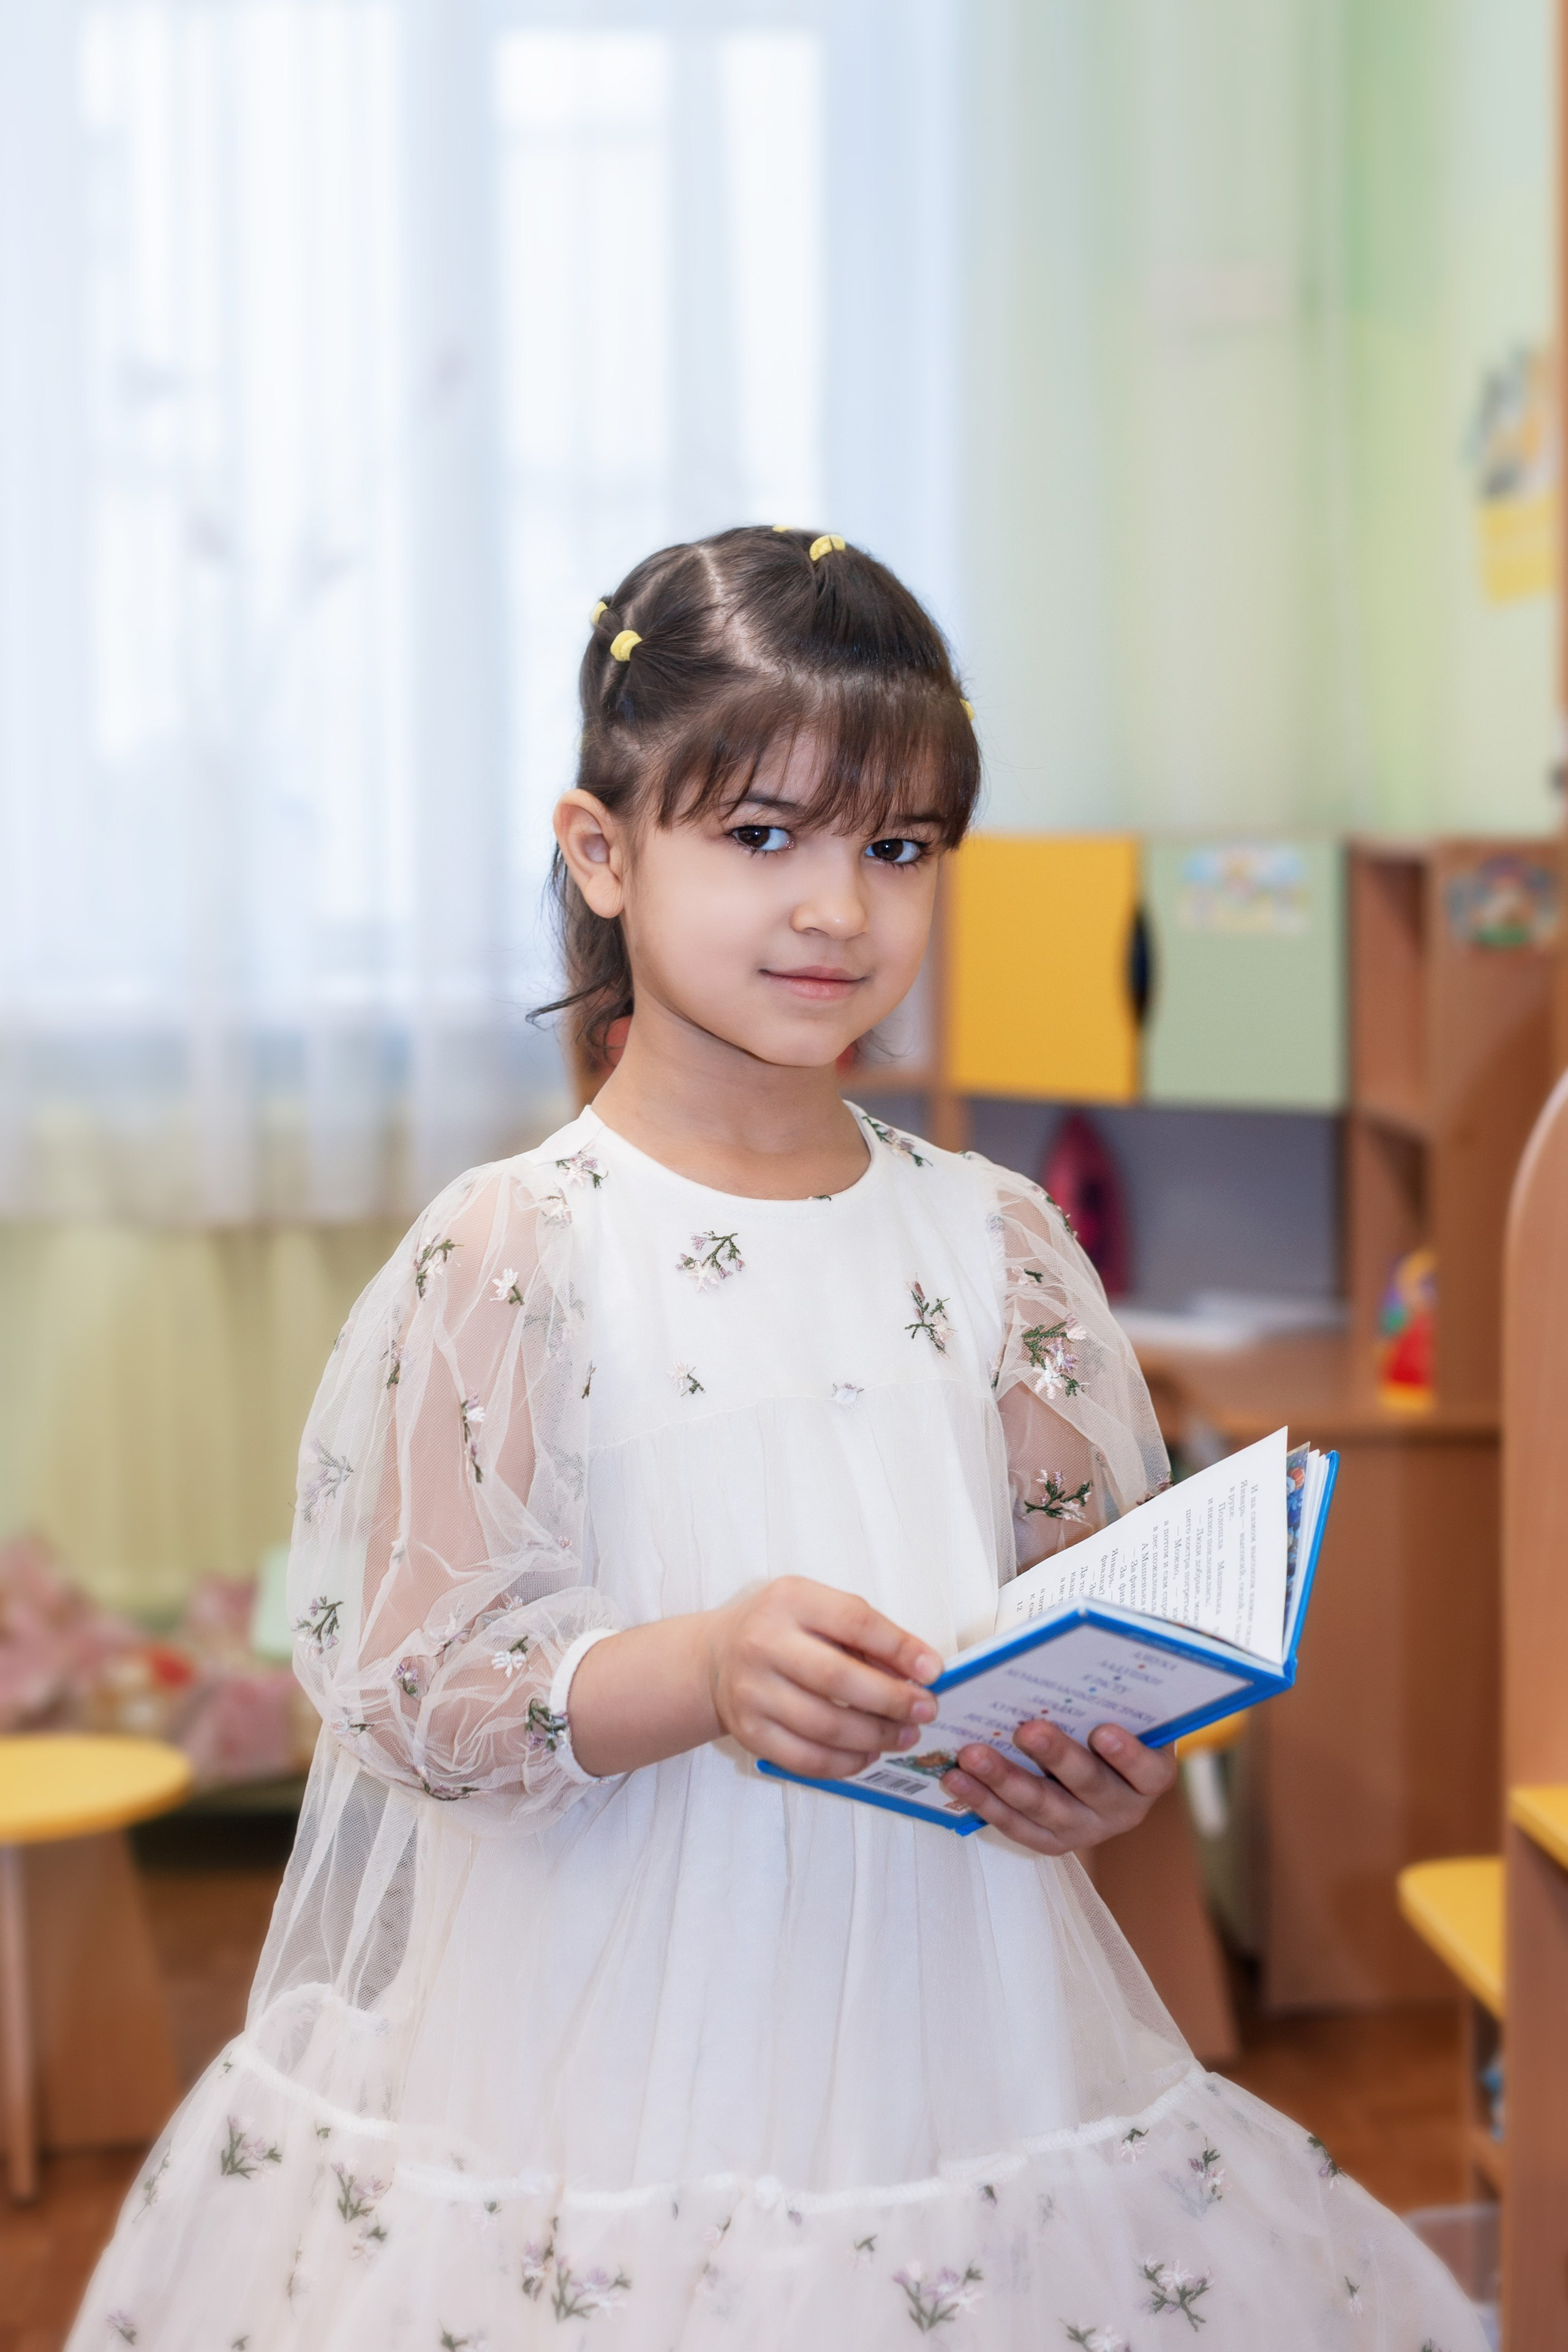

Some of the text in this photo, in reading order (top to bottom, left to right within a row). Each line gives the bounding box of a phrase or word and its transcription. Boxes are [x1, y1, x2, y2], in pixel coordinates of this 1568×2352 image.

[1251, 1484, 1259, 1494] И
[1238, 1480, 1248, 1517] Январь
[1251, 1496, 1256, 1509] на
[1196, 1528, 1204, 1556] Люди
[1172, 1539, 1182, 1580] Можно,
[1080, 1565, 1088, 1578] Да
[1120, 1566, 1127, 1578] За
[1131, 1560, 1137, 1573] За
[1098, 1555, 1108, 1596] фиалки?
[1193, 1559, 1202, 1599] добрые,
[1059, 1585, 1066, 1596] не
[1216, 1560, 1224, 1615] Машенька
[1017, 1600, 1023, 1612] 12
